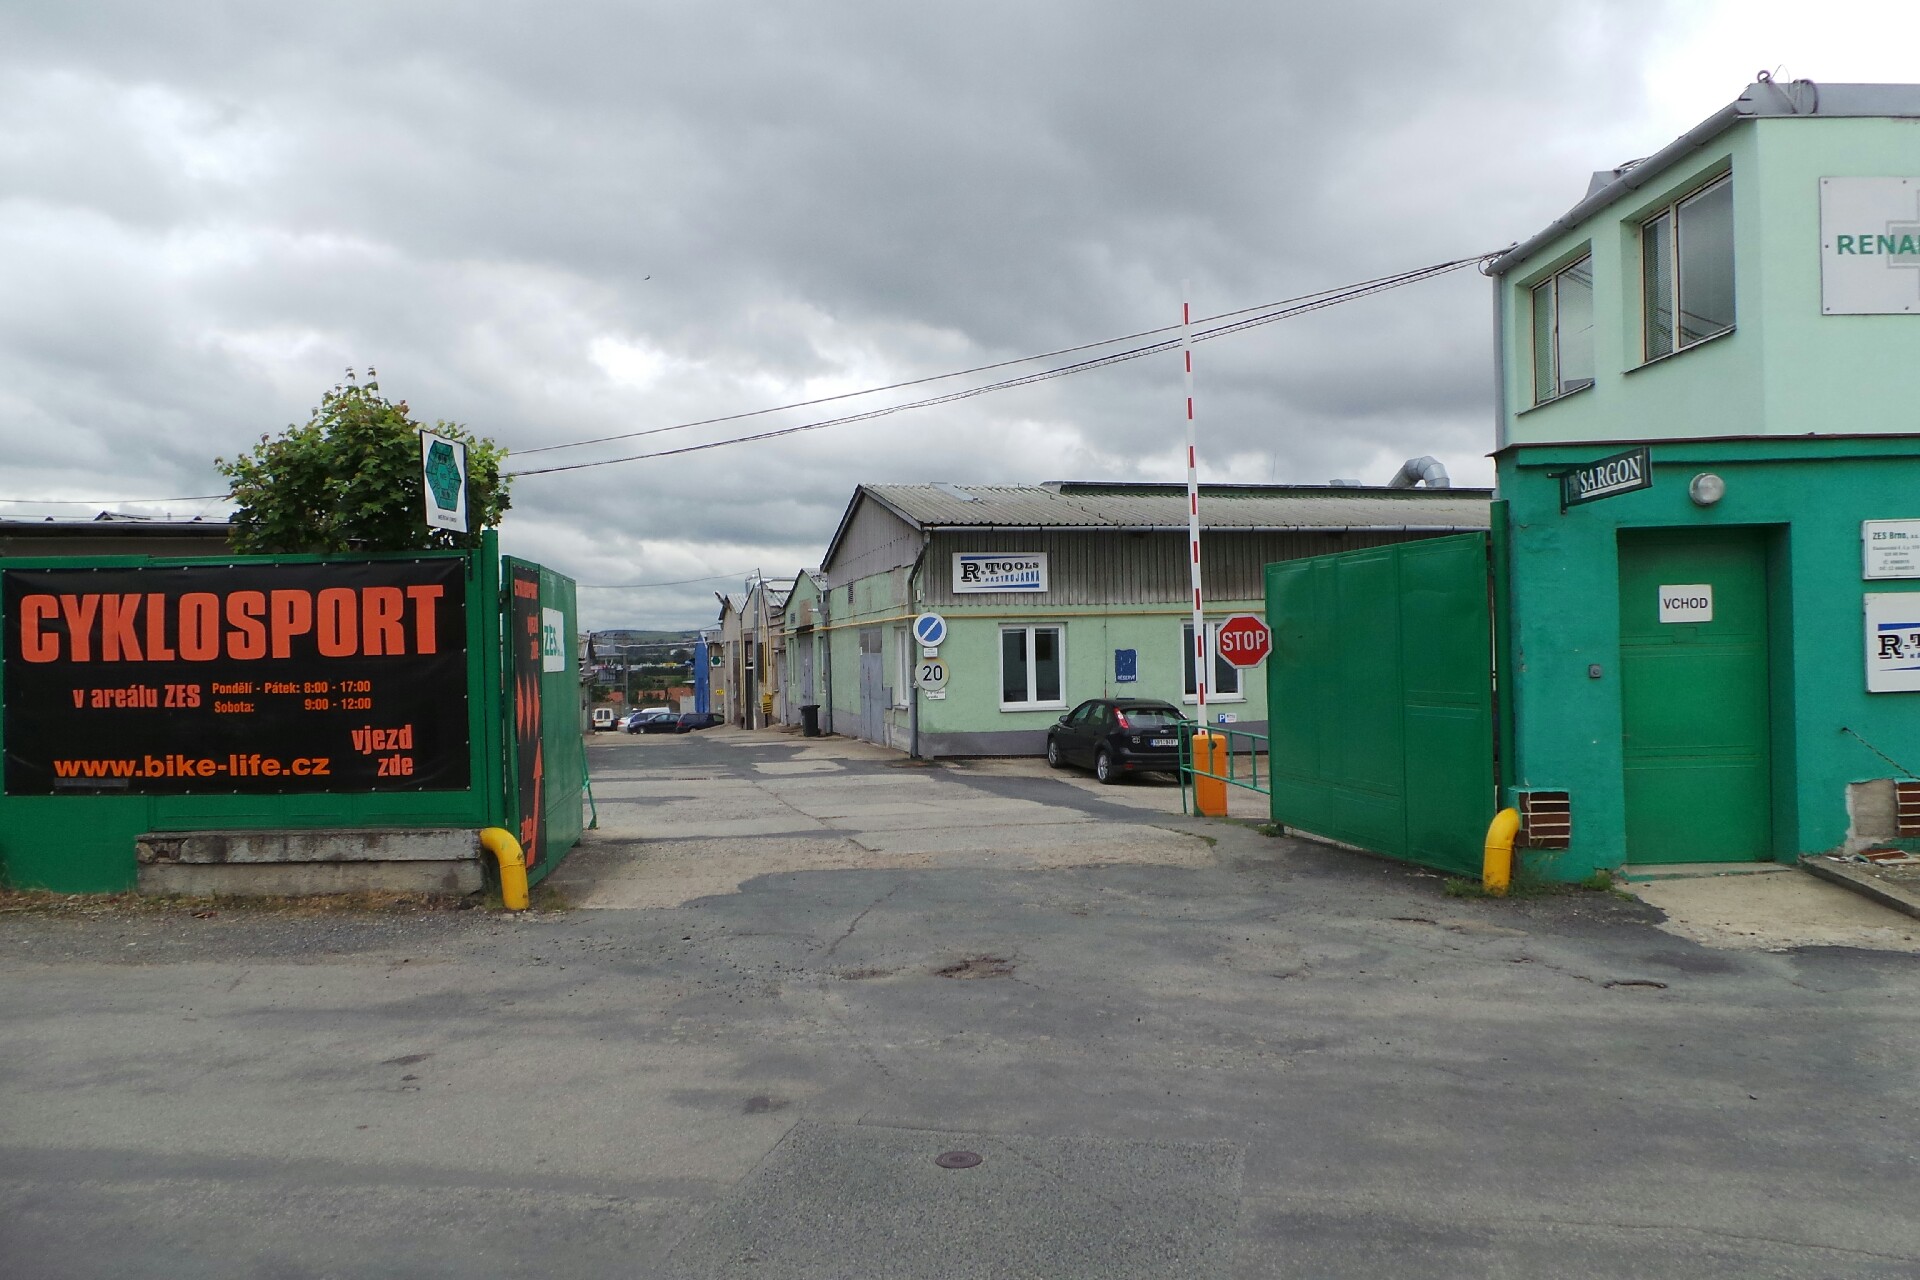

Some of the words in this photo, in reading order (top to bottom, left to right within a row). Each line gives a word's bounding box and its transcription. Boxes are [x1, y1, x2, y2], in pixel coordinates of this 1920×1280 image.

[1837, 234, 1920, 255] RENA
[1580, 455, 1643, 493] SARGON
[1872, 532, 1887, 540] ZES
[960, 562, 1040, 582] R-TOOLS
[1663, 597, 1708, 610] VCHOD
[20, 584, 444, 663] CYKLOSPORT
[1222, 630, 1266, 652] STOP
[922, 665, 943, 681] 20
[73, 690, 84, 708] v
[91, 684, 158, 708] areálu
[164, 685, 201, 708] ZES
[212, 682, 252, 694] Pondělí
[264, 682, 300, 694] Pátek:
[304, 681, 328, 693] 8:00
[340, 680, 371, 692] 17:00
[214, 701, 255, 713] Sobota:
[304, 699, 329, 710] 9:00
[341, 698, 371, 710] 12:00
[351, 724, 413, 755] vjezd
[53, 754, 331, 778] www.bike-life.cz
[377, 754, 414, 777] zde
